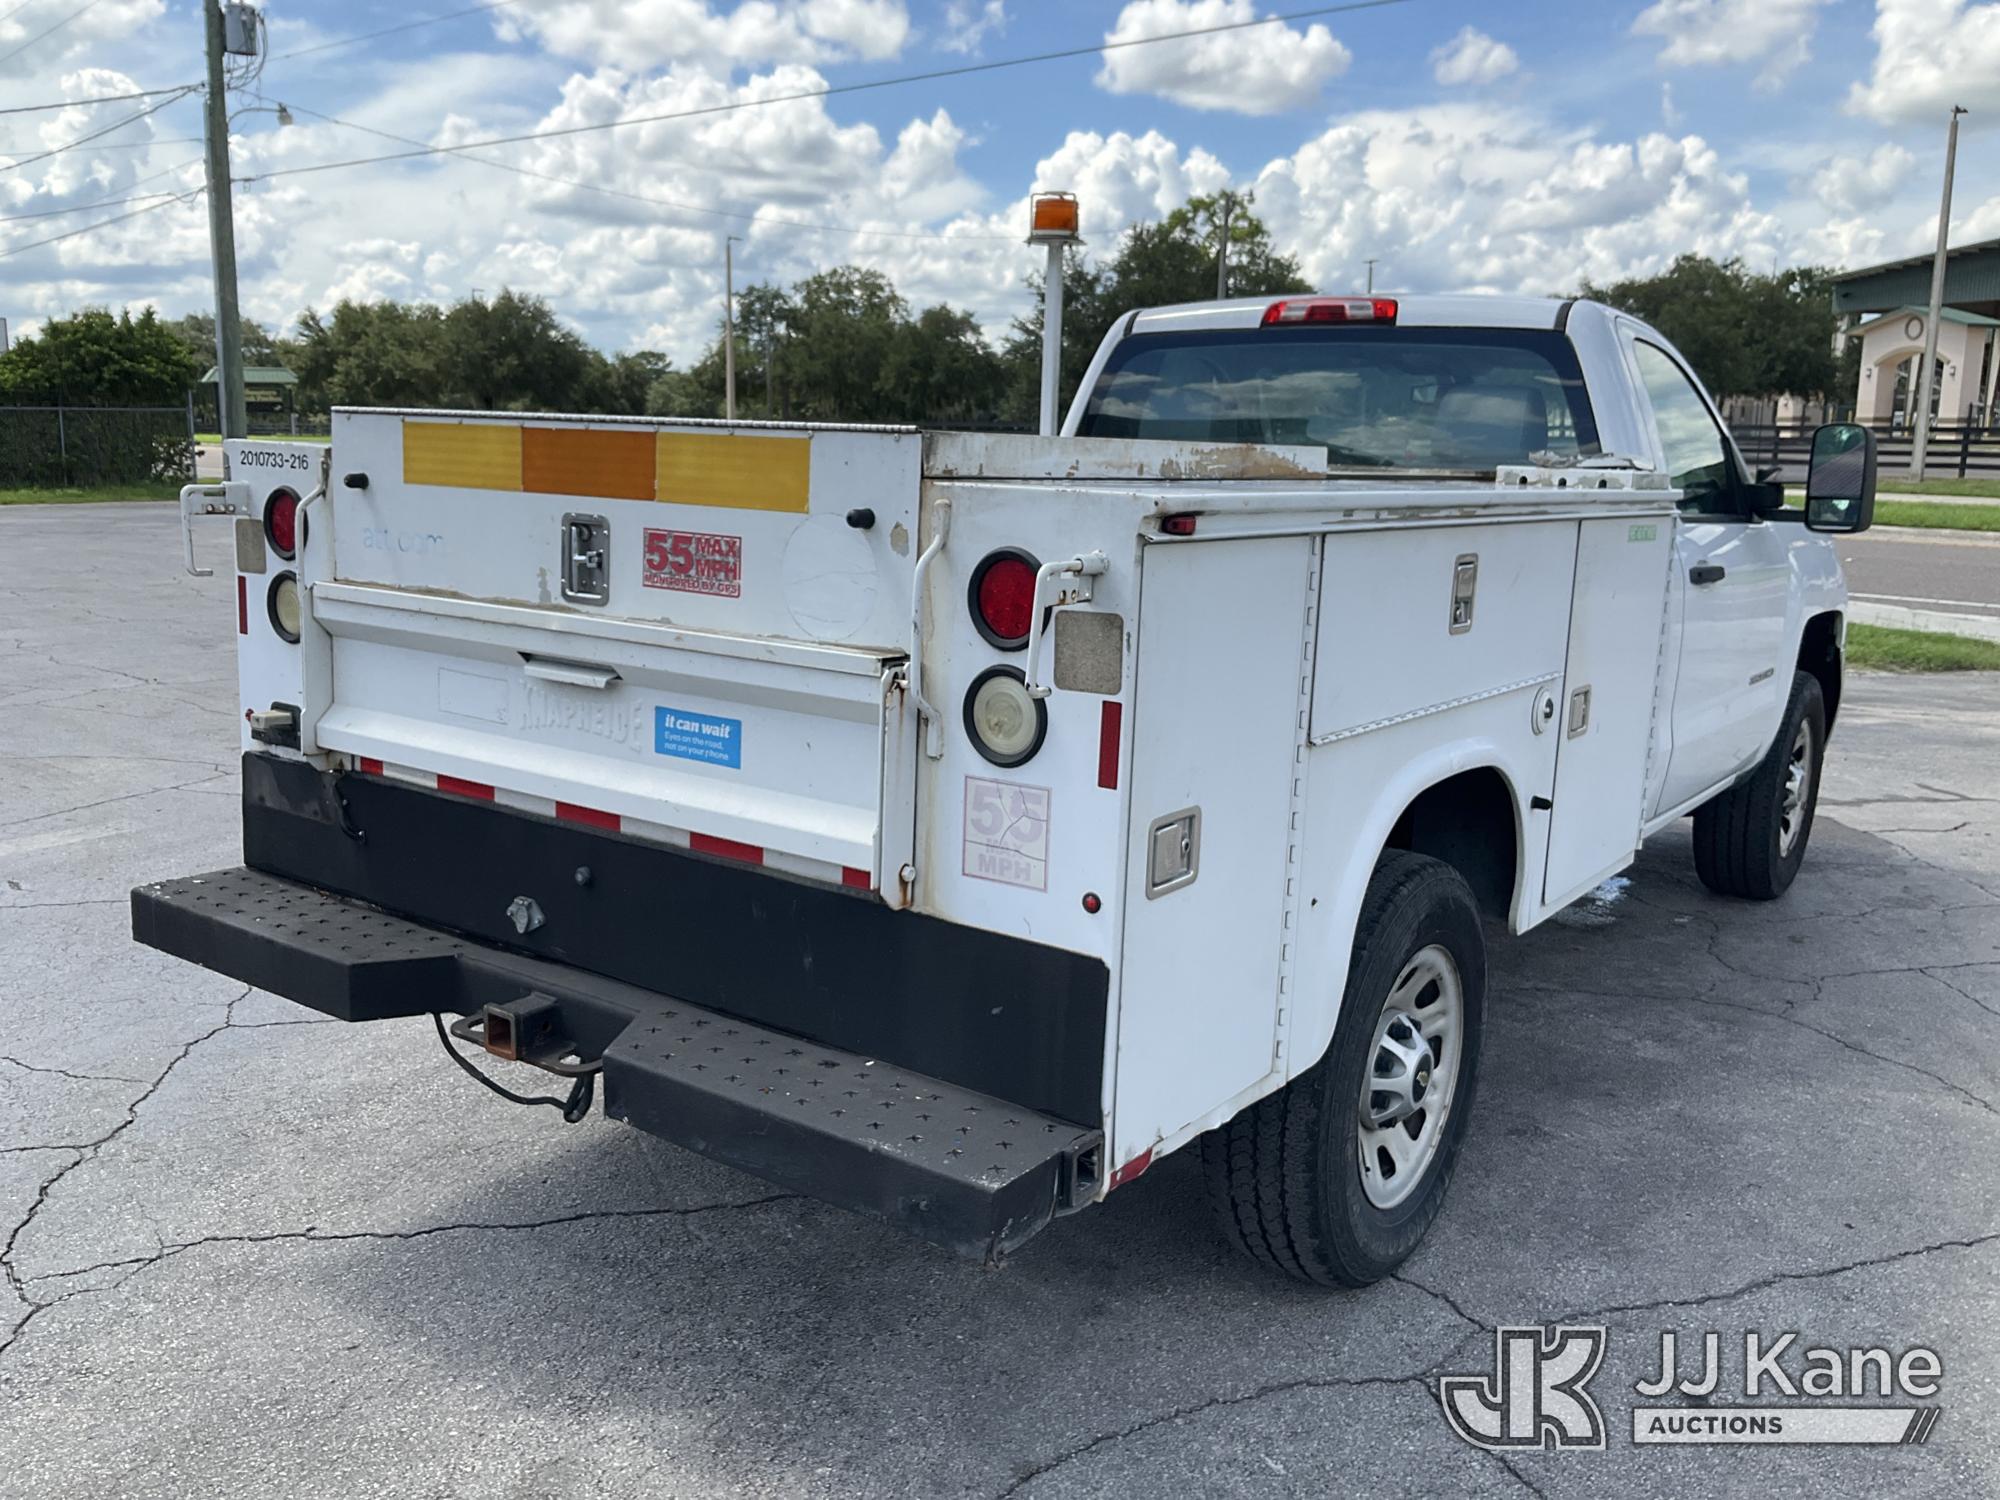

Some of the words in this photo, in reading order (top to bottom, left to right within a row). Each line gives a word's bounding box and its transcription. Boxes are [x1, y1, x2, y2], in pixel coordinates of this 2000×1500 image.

[240, 449, 309, 470] 2010733-216
[646, 532, 694, 575] 55
[696, 536, 738, 558] MAX
[696, 559, 738, 580] MPH
[701, 580, 716, 591] BY
[717, 582, 738, 595] GPS
[665, 714, 675, 728] it
[676, 719, 700, 733] can
[701, 723, 731, 739] wait
[664, 731, 681, 742] Eyes
[682, 735, 691, 743] on
[691, 736, 705, 746] the
[664, 742, 677, 750] not
[688, 746, 704, 756] your
[704, 749, 729, 761] phone
[970, 784, 1045, 844] 55
[978, 853, 1031, 881] MPH
